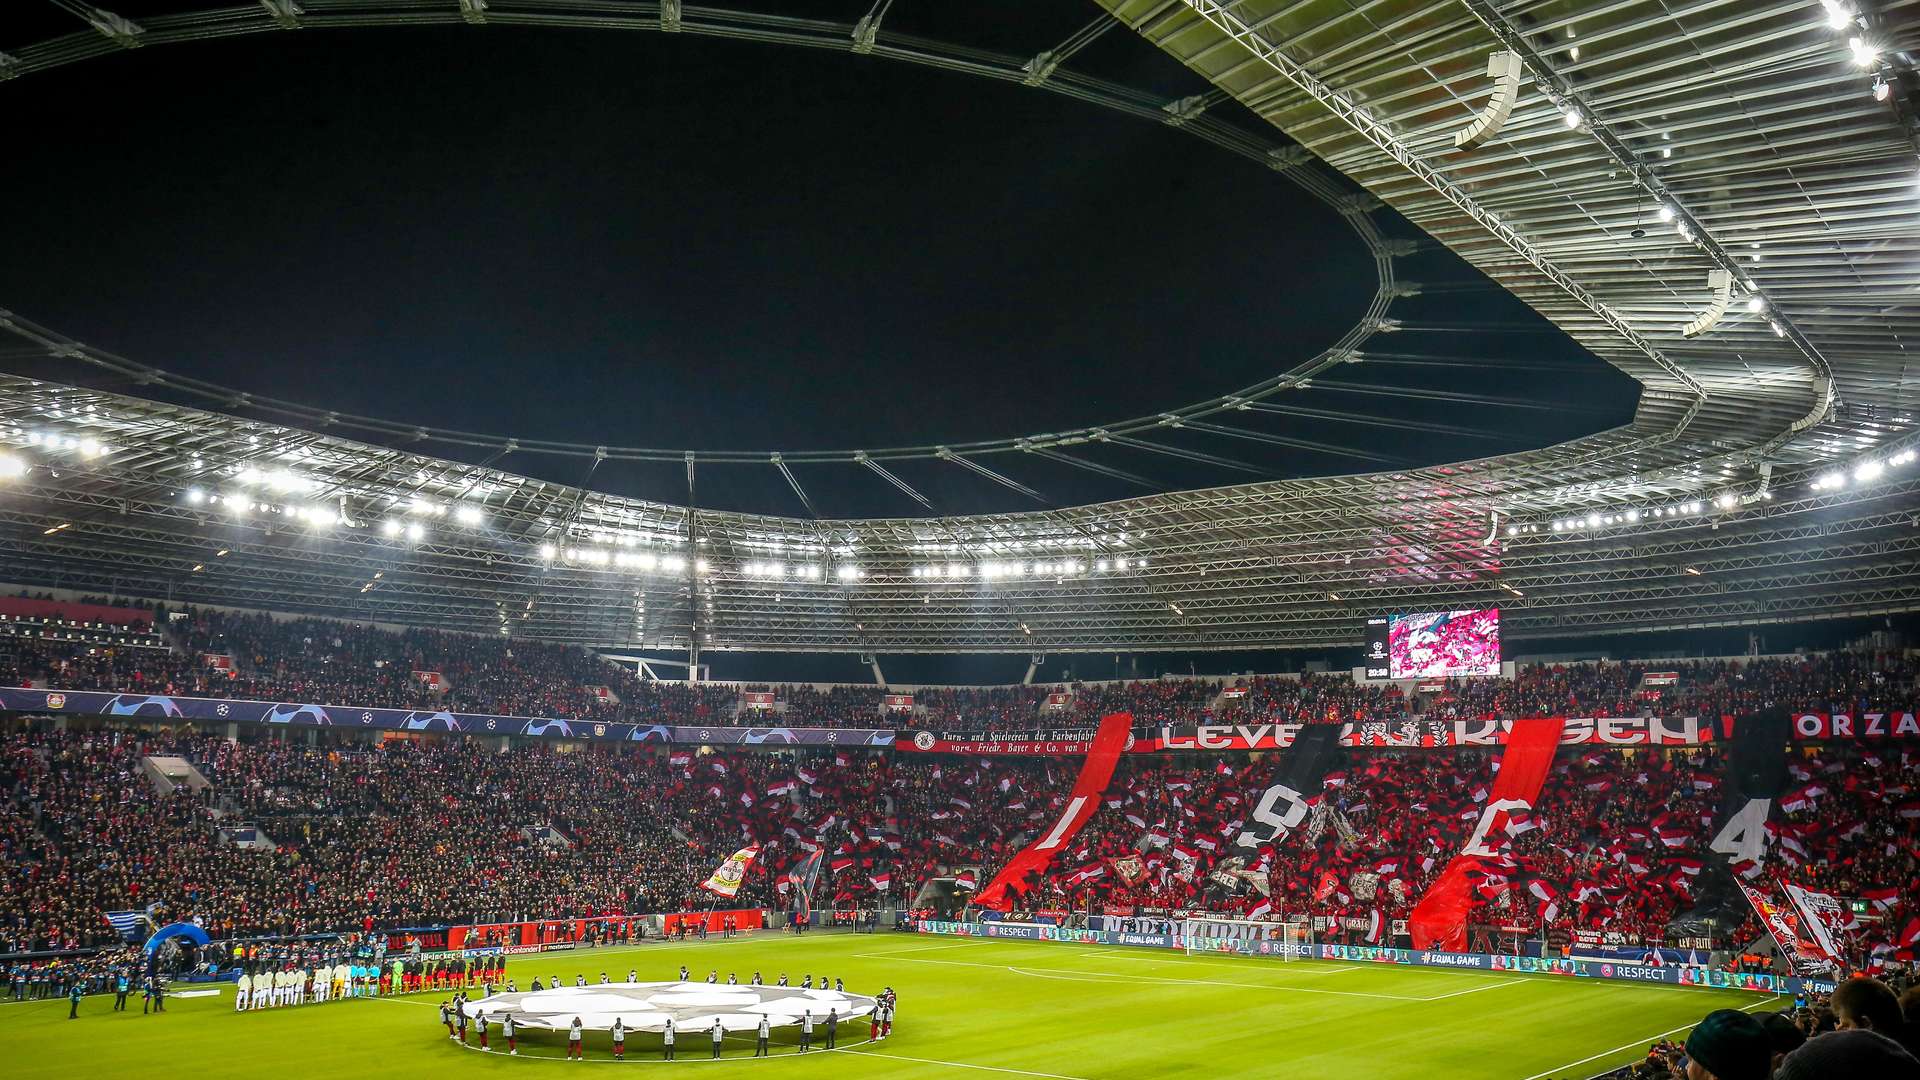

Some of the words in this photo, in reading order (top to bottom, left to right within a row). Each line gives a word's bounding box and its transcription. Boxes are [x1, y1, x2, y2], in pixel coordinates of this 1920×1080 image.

[1455, 717, 1698, 745] KSEN
[1797, 713, 1920, 736] ORZA
[972, 732, 985, 742] und
[991, 730, 1029, 744] Spielverein
[1034, 730, 1047, 741] der
[1051, 729, 1097, 743] Farbenfabri
[1008, 742, 1029, 753] Bayer
[1034, 742, 1041, 752] &
[1046, 741, 1059, 752] Co.
[1065, 743, 1078, 752] von
[1034, 796, 1088, 850] 1
[1237, 784, 1308, 848] 9
[1709, 798, 1772, 866] 4
[999, 927, 1032, 938] RESPECT
[509, 946, 539, 954] Santander
[1273, 942, 1313, 956] RESPECT
[1617, 966, 1667, 980] RESPECT
